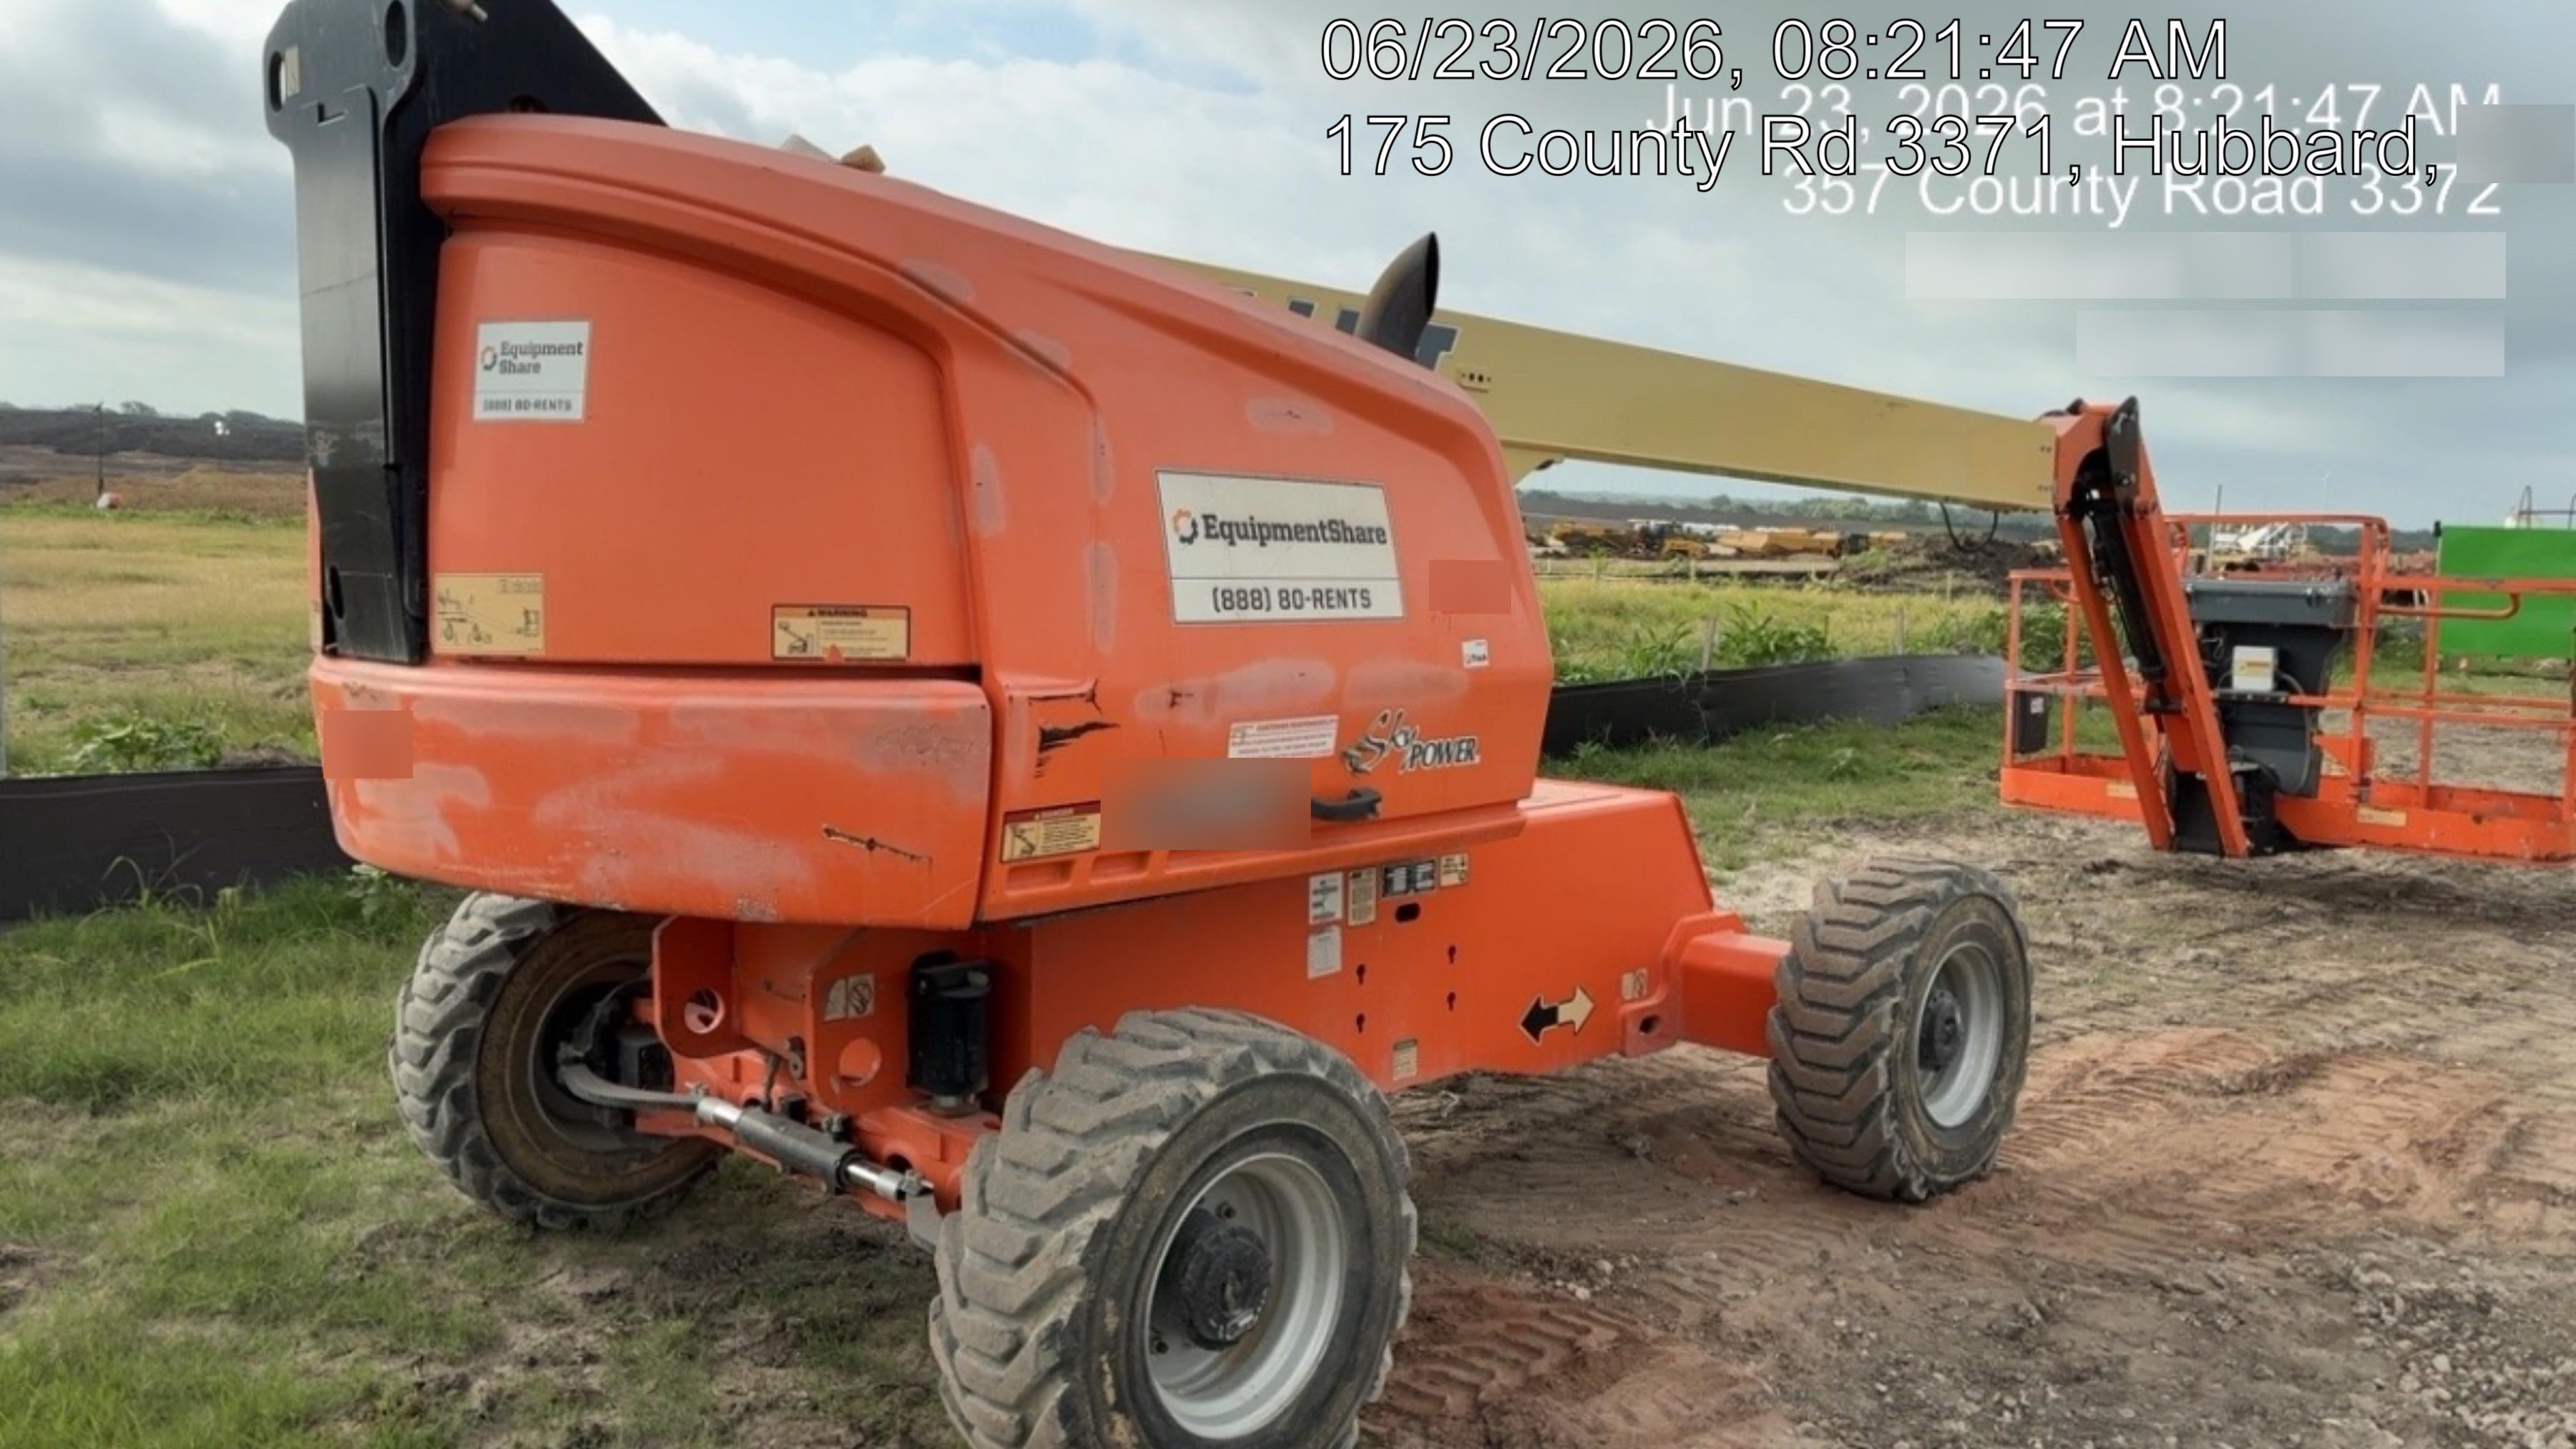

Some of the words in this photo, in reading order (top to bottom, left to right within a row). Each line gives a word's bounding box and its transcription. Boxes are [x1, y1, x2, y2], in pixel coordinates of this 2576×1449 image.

[501, 341, 583, 358] Equipment
[499, 359, 542, 374] Share
[1201, 514, 1387, 547] EquipmentShare
[1212, 587, 1272, 613] (888)
[1278, 587, 1372, 610] 80-RENTS
[1407, 736, 1483, 771] POWER
